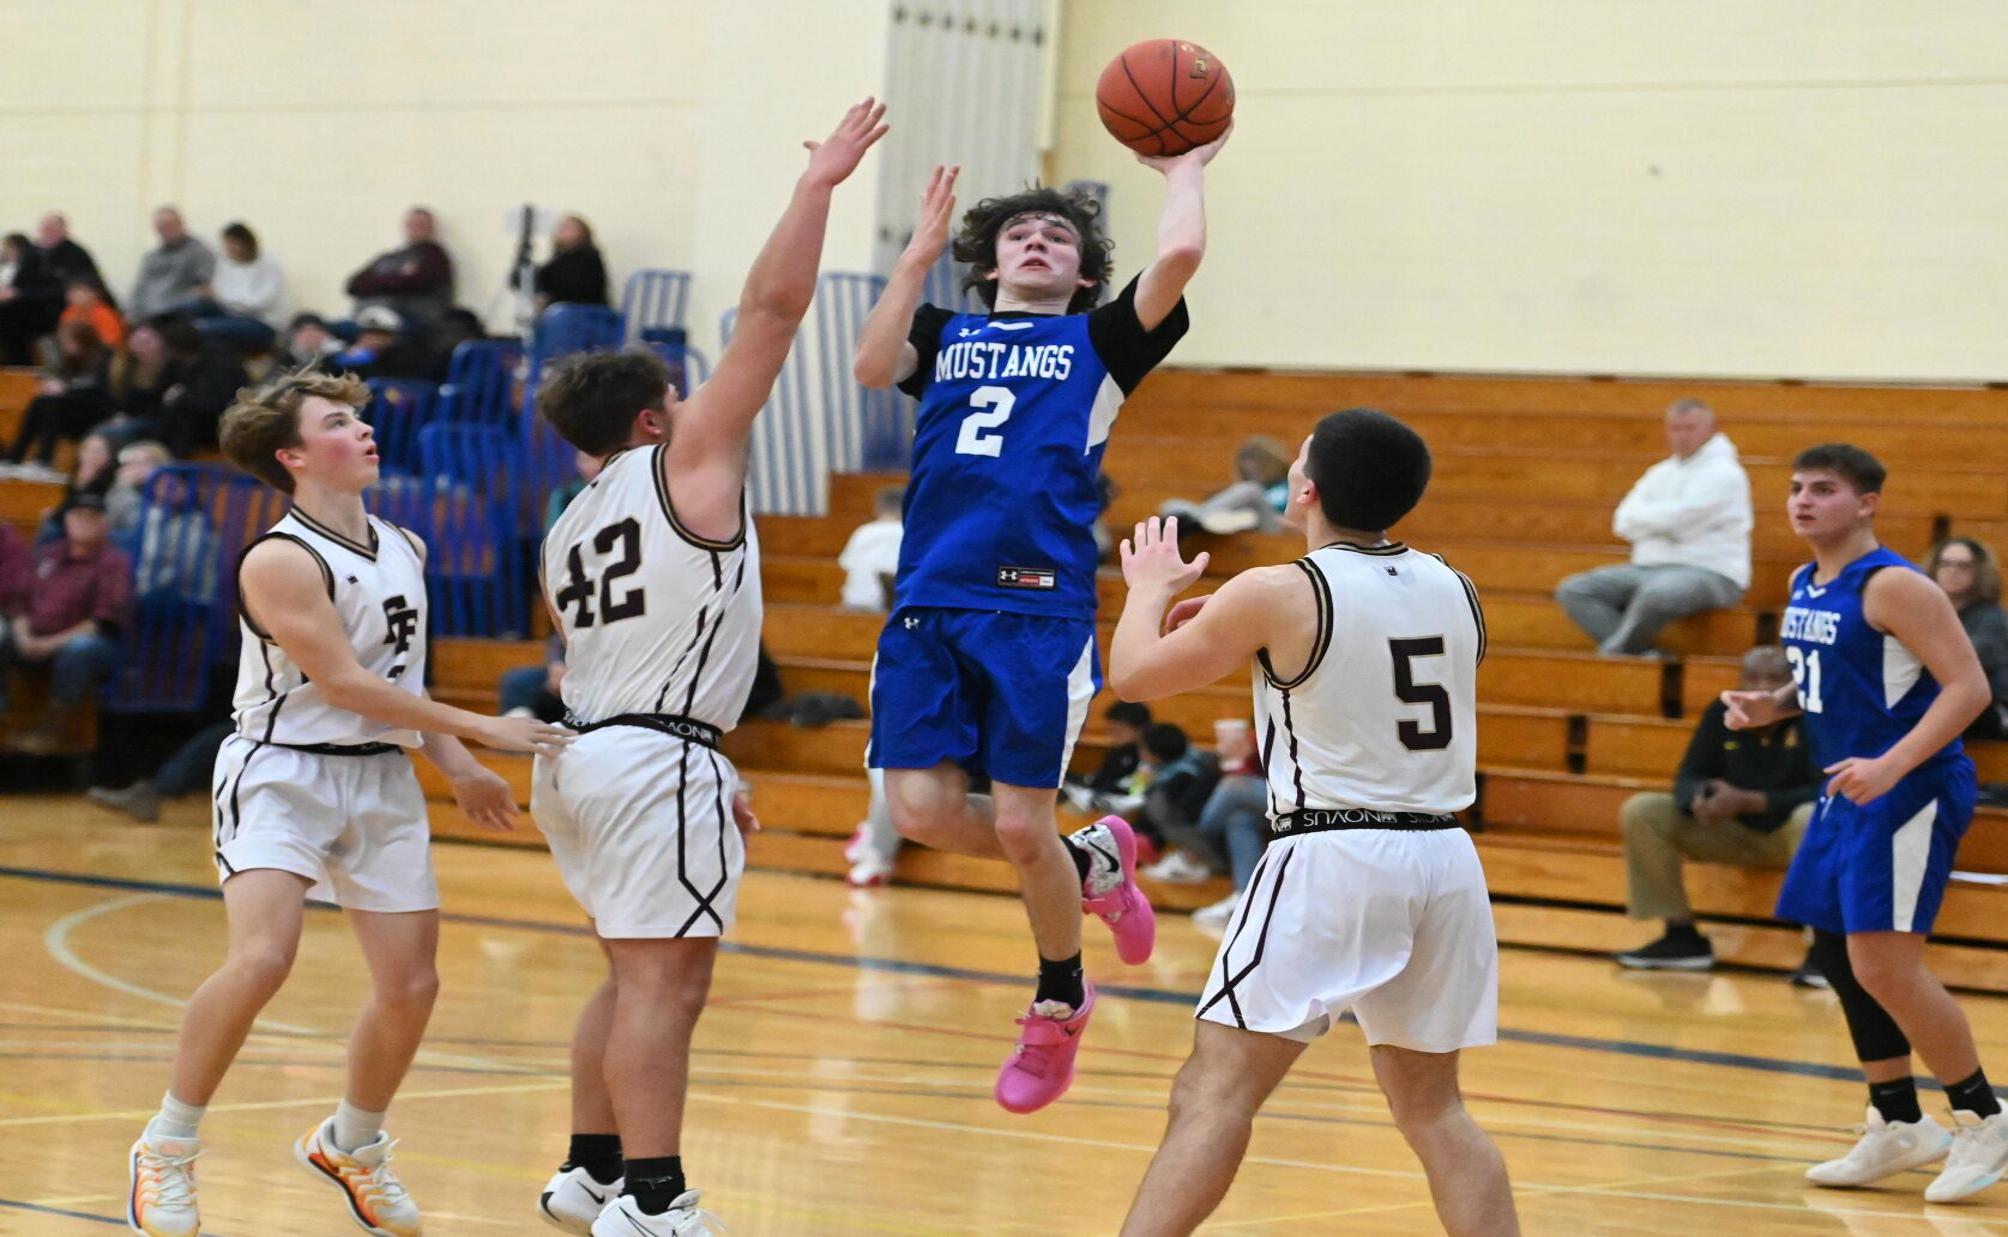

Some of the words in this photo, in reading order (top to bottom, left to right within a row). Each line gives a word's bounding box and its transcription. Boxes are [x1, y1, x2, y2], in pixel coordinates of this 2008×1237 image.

[935, 342, 1075, 382] MUSTANGS
[955, 386, 1016, 457] 2
[556, 516, 645, 628] 42
[1387, 635, 1453, 751] 5
[1786, 645, 1822, 714] 21
[1303, 808, 1381, 827] NOVUS
